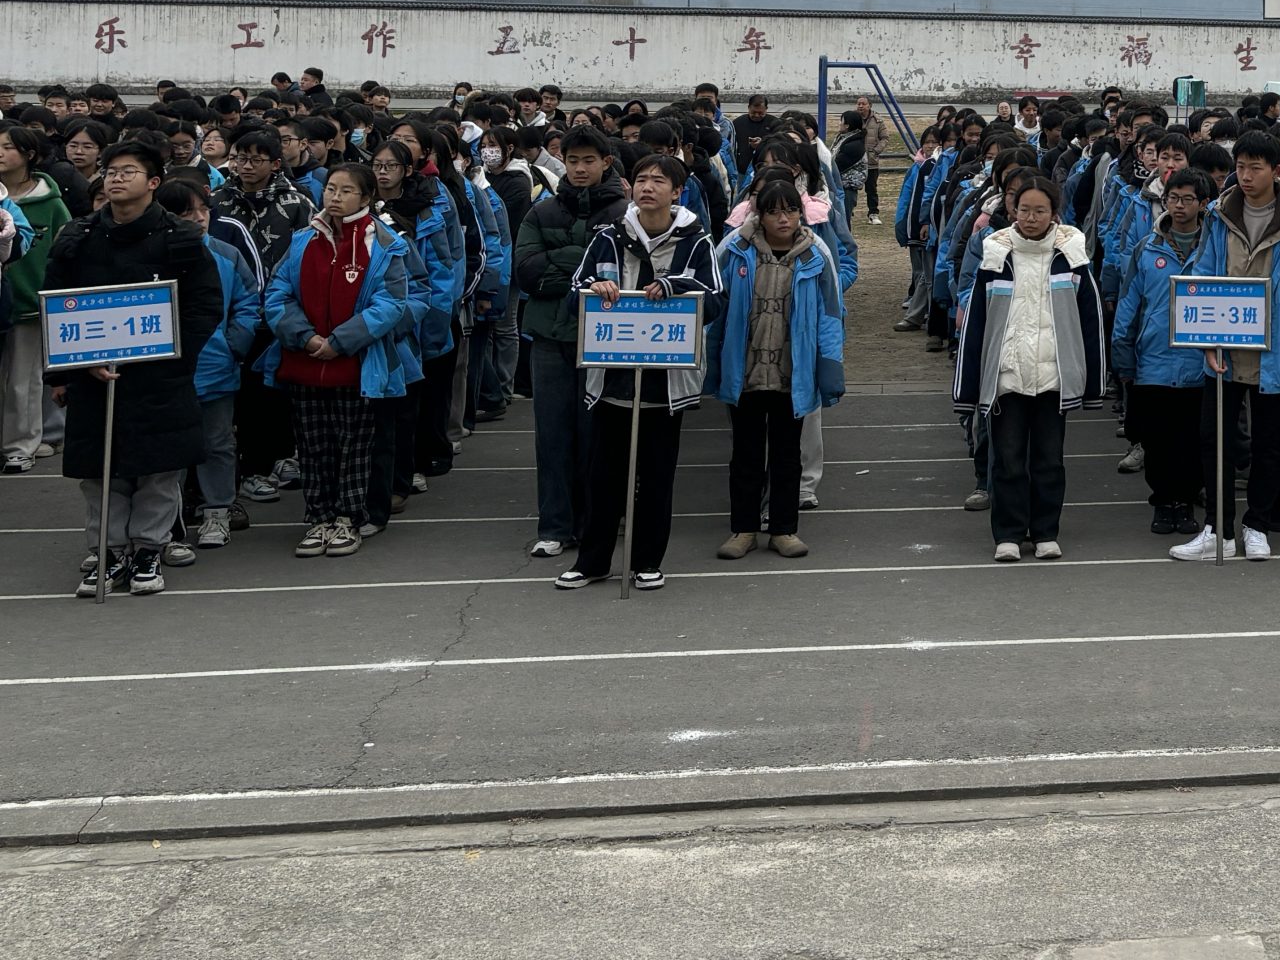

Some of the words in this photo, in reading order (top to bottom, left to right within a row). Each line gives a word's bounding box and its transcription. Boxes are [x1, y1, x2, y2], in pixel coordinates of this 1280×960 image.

[1183, 305, 1258, 324] 初三·3班
[59, 314, 162, 343] 初三·1班
[594, 321, 687, 343] 初三·2班
